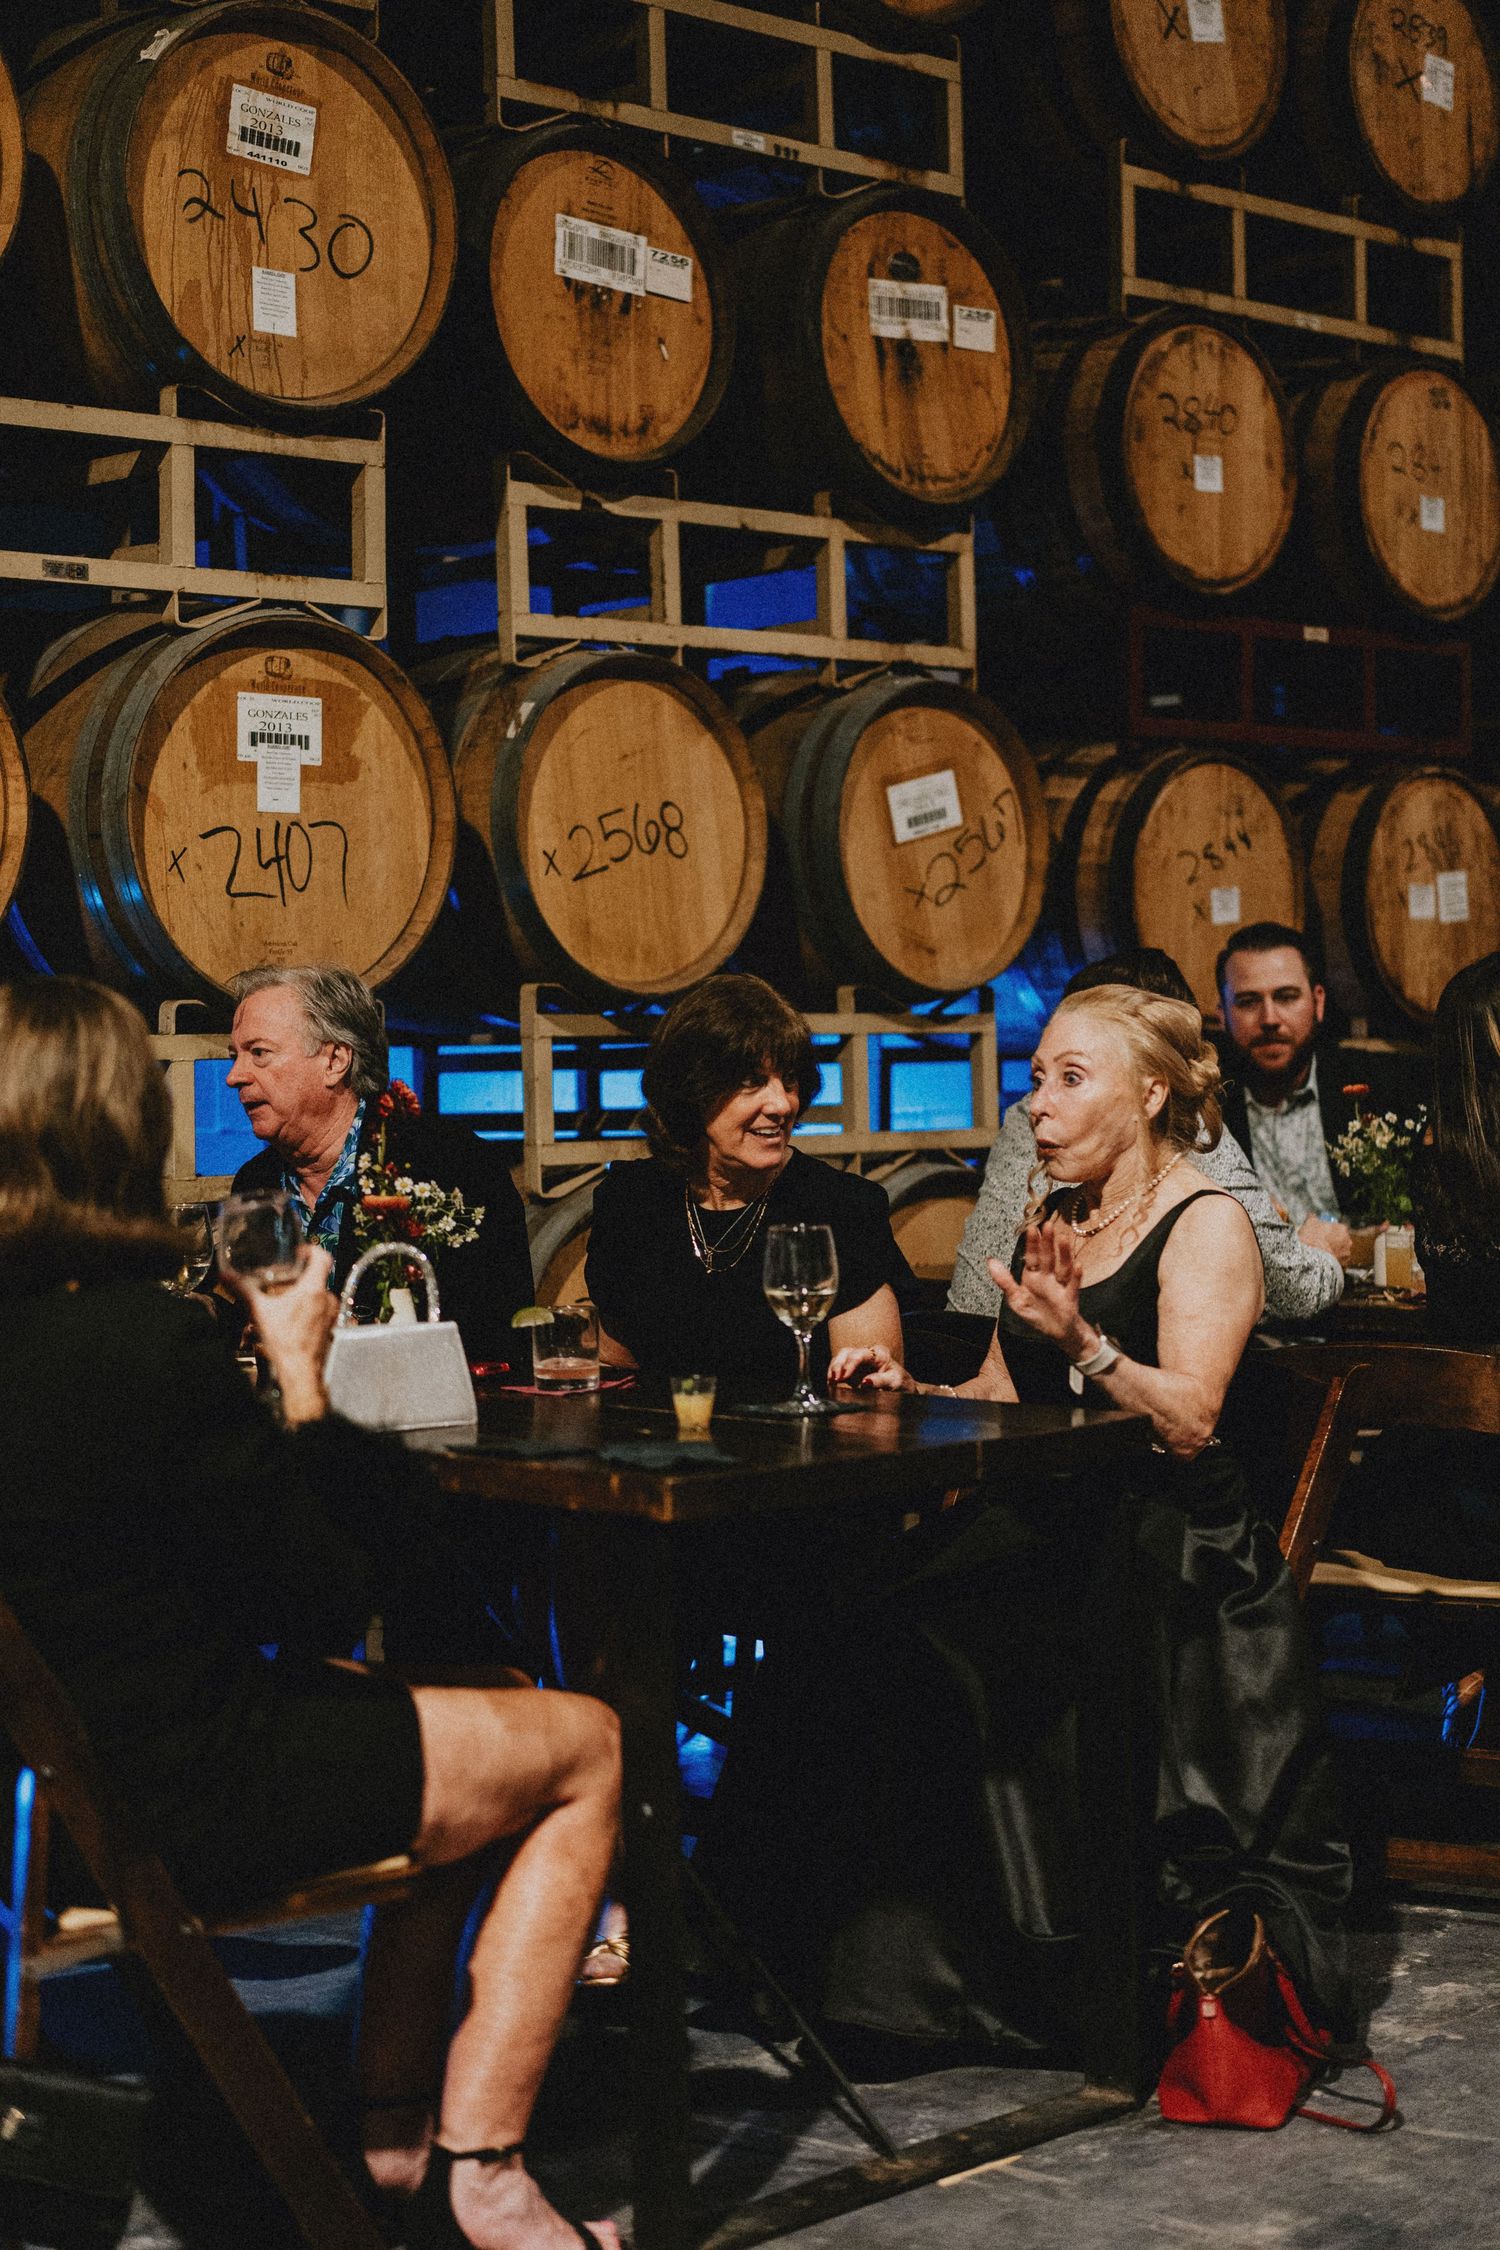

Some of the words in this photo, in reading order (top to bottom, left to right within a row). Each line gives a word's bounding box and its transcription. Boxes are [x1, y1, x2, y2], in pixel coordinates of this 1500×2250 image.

[240, 103, 301, 128] GONZALES
[249, 118, 284, 136] 2013
[246, 151, 288, 167] 441110
[178, 168, 375, 280] 2430
[247, 708, 309, 721] GONZALES
[258, 721, 293, 733] 2013
[198, 819, 350, 909] 2407
